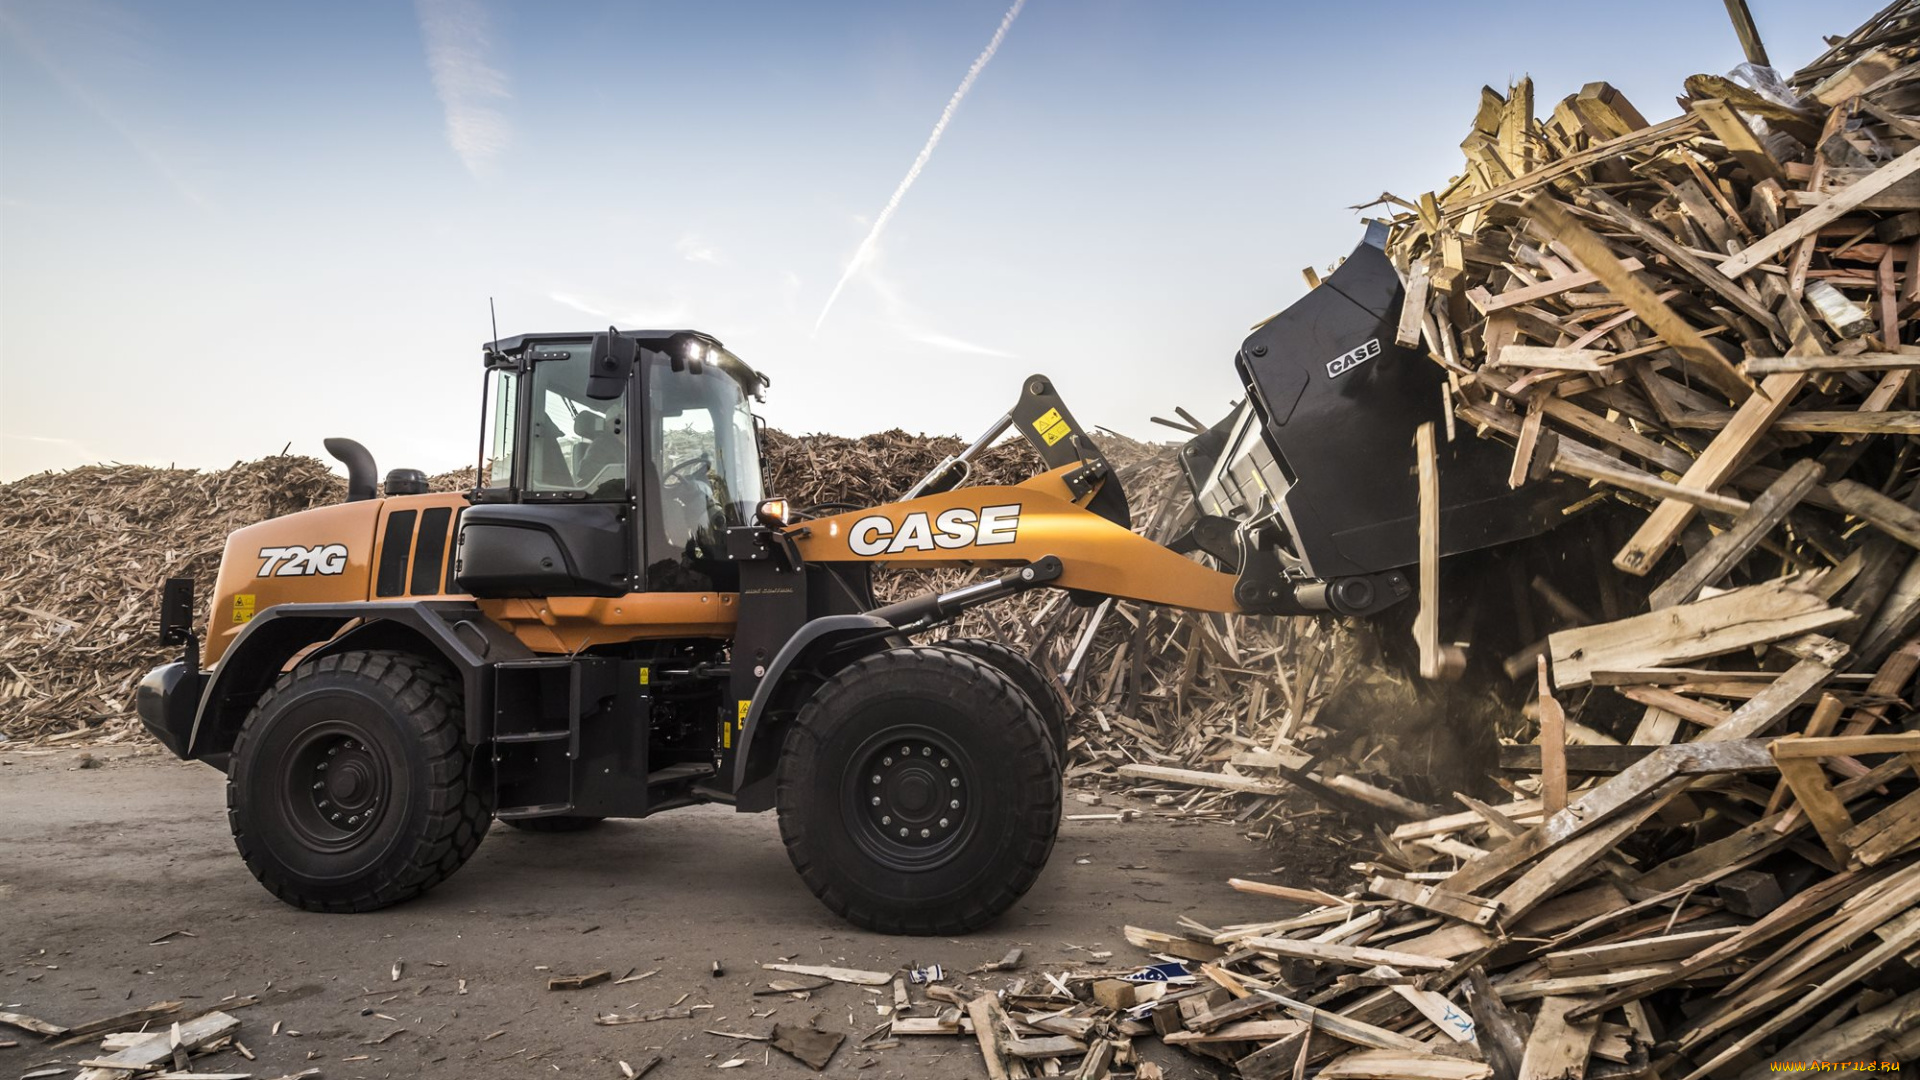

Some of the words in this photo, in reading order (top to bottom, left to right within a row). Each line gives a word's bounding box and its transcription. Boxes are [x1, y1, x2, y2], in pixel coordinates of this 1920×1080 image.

[1329, 340, 1380, 374] CASE
[848, 503, 1022, 556] CASE
[256, 543, 348, 578] 721G
